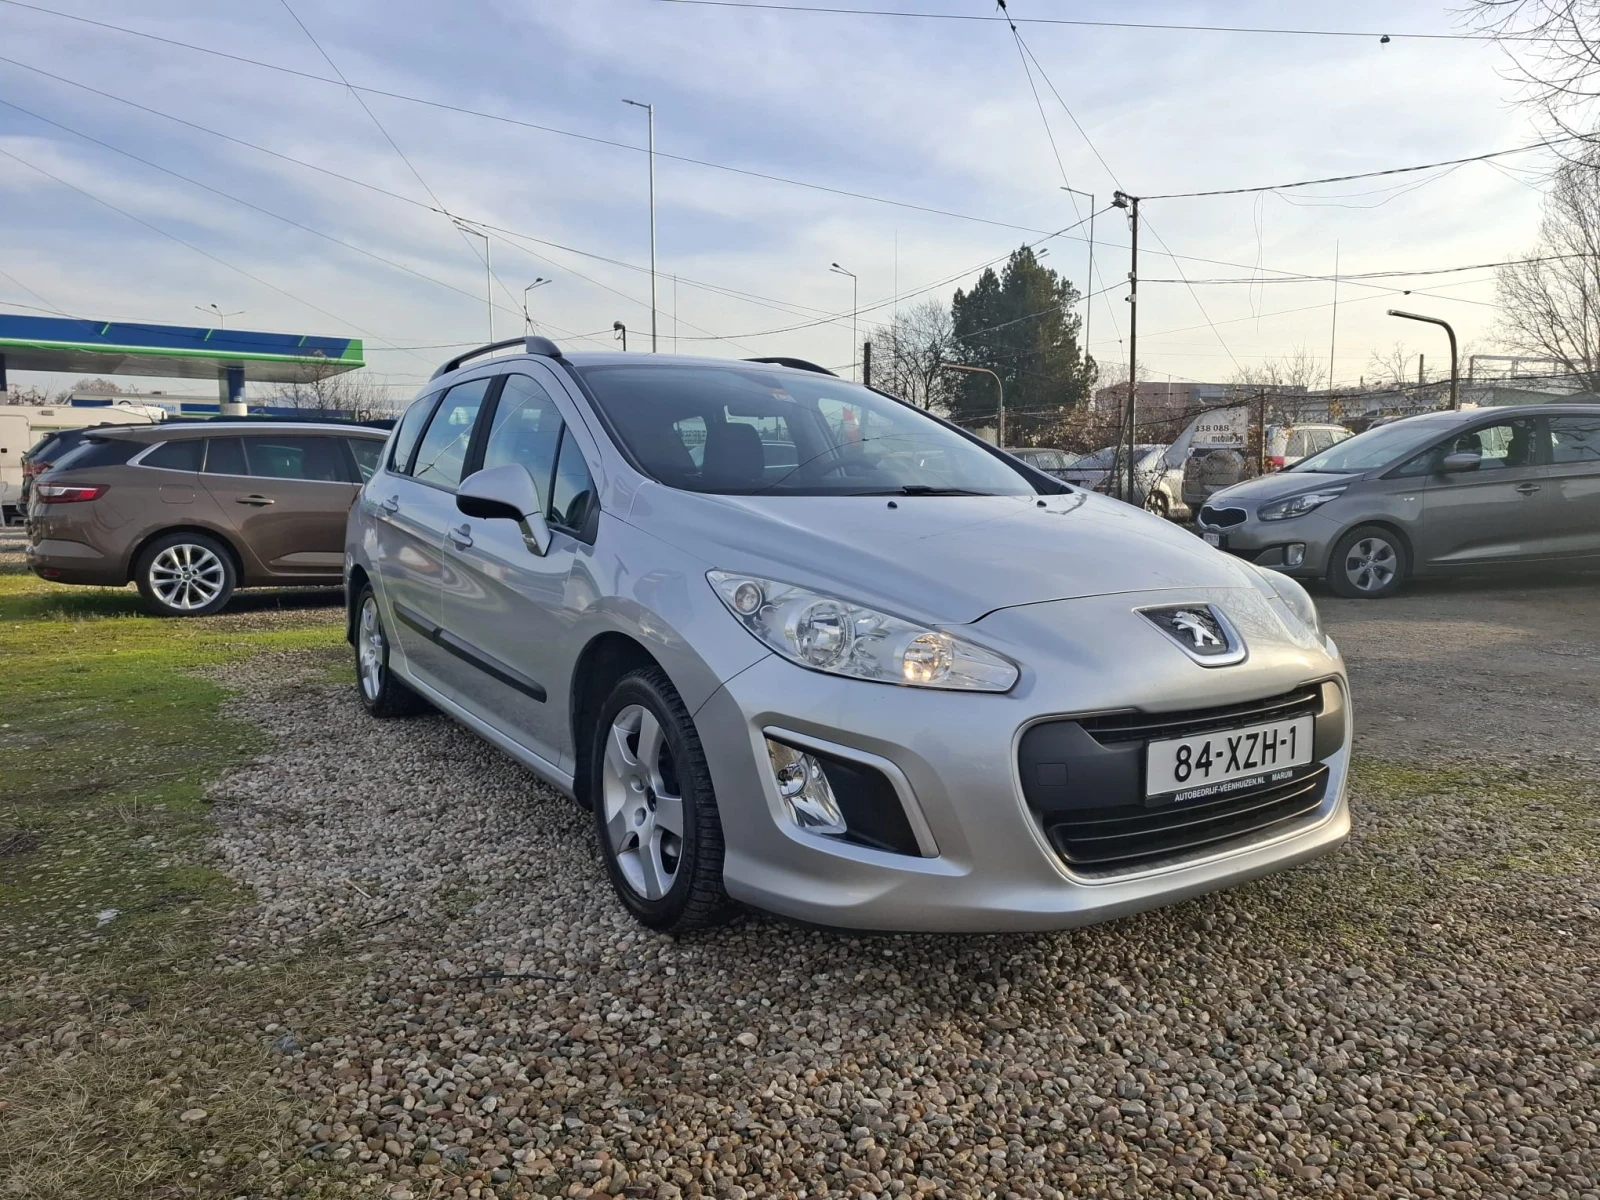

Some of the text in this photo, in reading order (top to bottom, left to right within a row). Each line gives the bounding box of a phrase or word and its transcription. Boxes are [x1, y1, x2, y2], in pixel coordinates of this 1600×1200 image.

[1174, 725, 1297, 783] 84-XZH-1
[1174, 769, 1293, 802] AUTOBEDRIJF-VEENHUIZEN.NL MARUM
